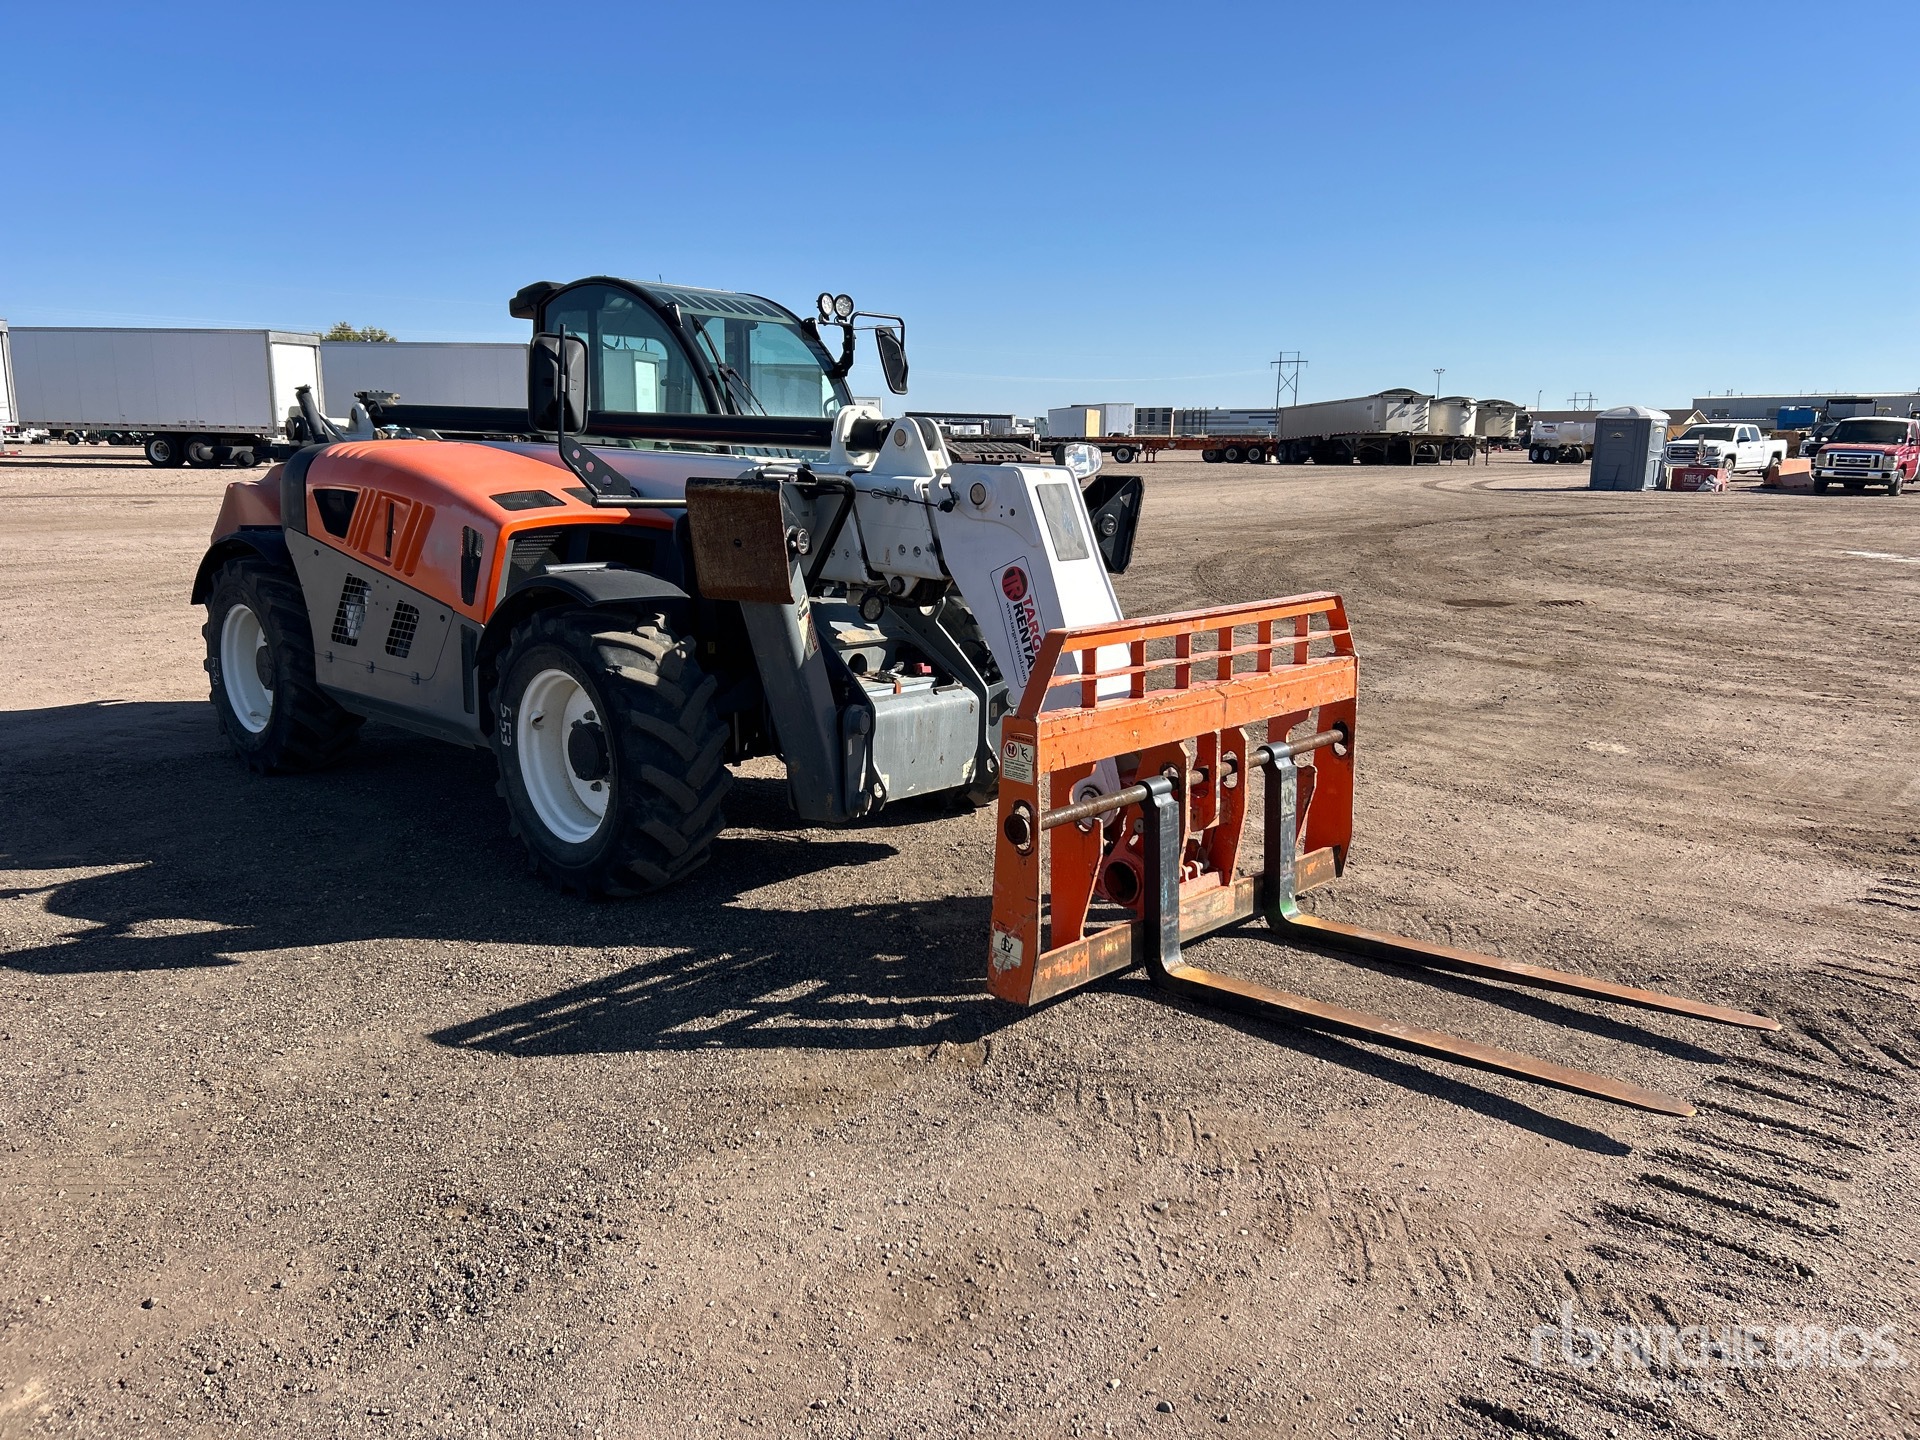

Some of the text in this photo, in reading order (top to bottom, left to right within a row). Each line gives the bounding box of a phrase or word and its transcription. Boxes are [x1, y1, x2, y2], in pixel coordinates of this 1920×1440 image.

[1006, 602, 1028, 682] www.targetrental.com
[1013, 602, 1036, 674] RENTA
[1023, 595, 1043, 656] TARG
[500, 702, 512, 747] 553
